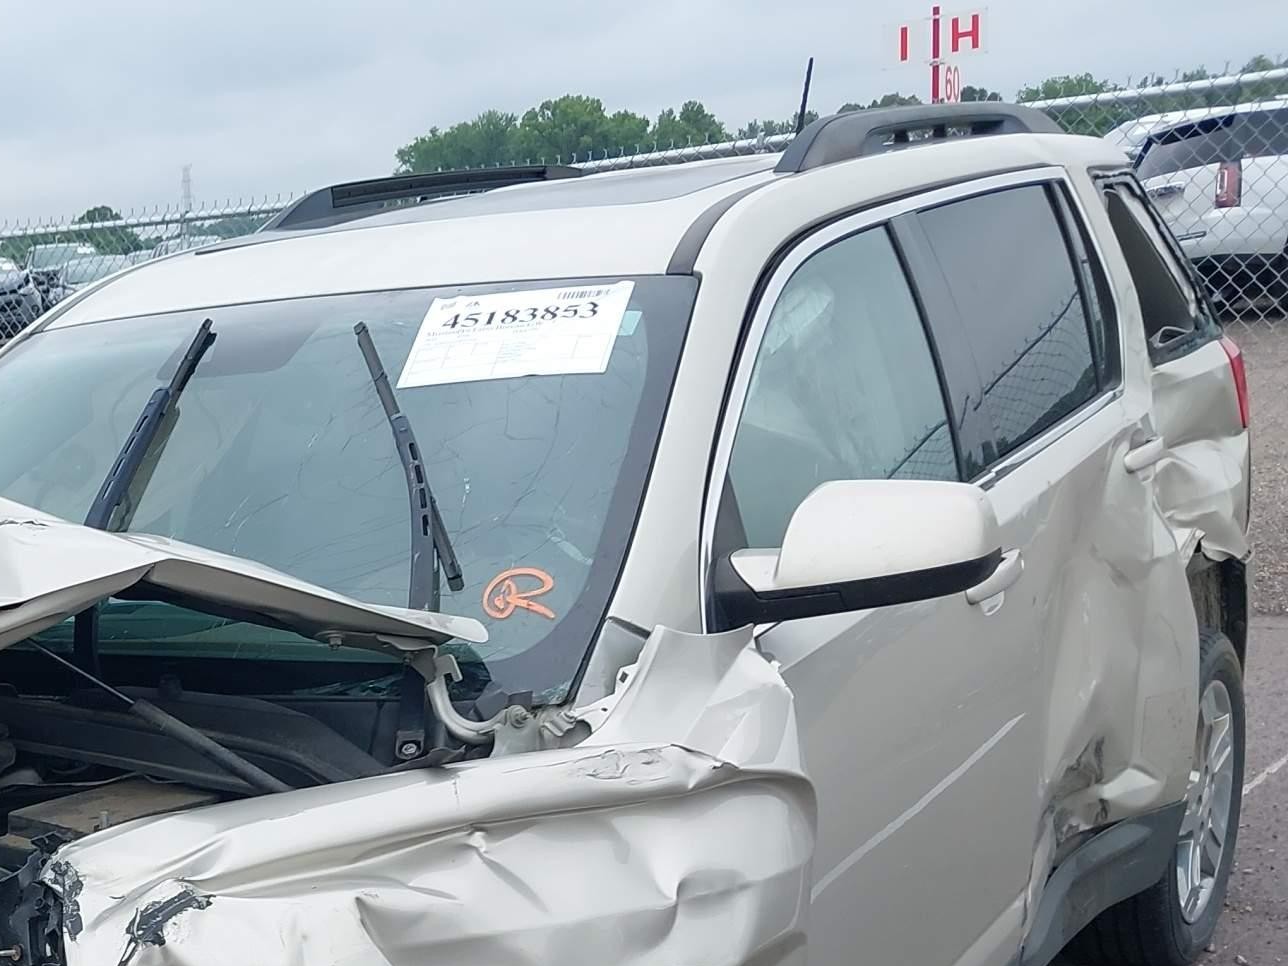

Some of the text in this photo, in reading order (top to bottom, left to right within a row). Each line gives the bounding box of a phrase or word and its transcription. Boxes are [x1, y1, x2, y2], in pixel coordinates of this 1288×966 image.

[952, 14, 979, 52] H
[945, 66, 960, 102] 60
[442, 301, 600, 329] 45183853
[482, 567, 556, 619] R
